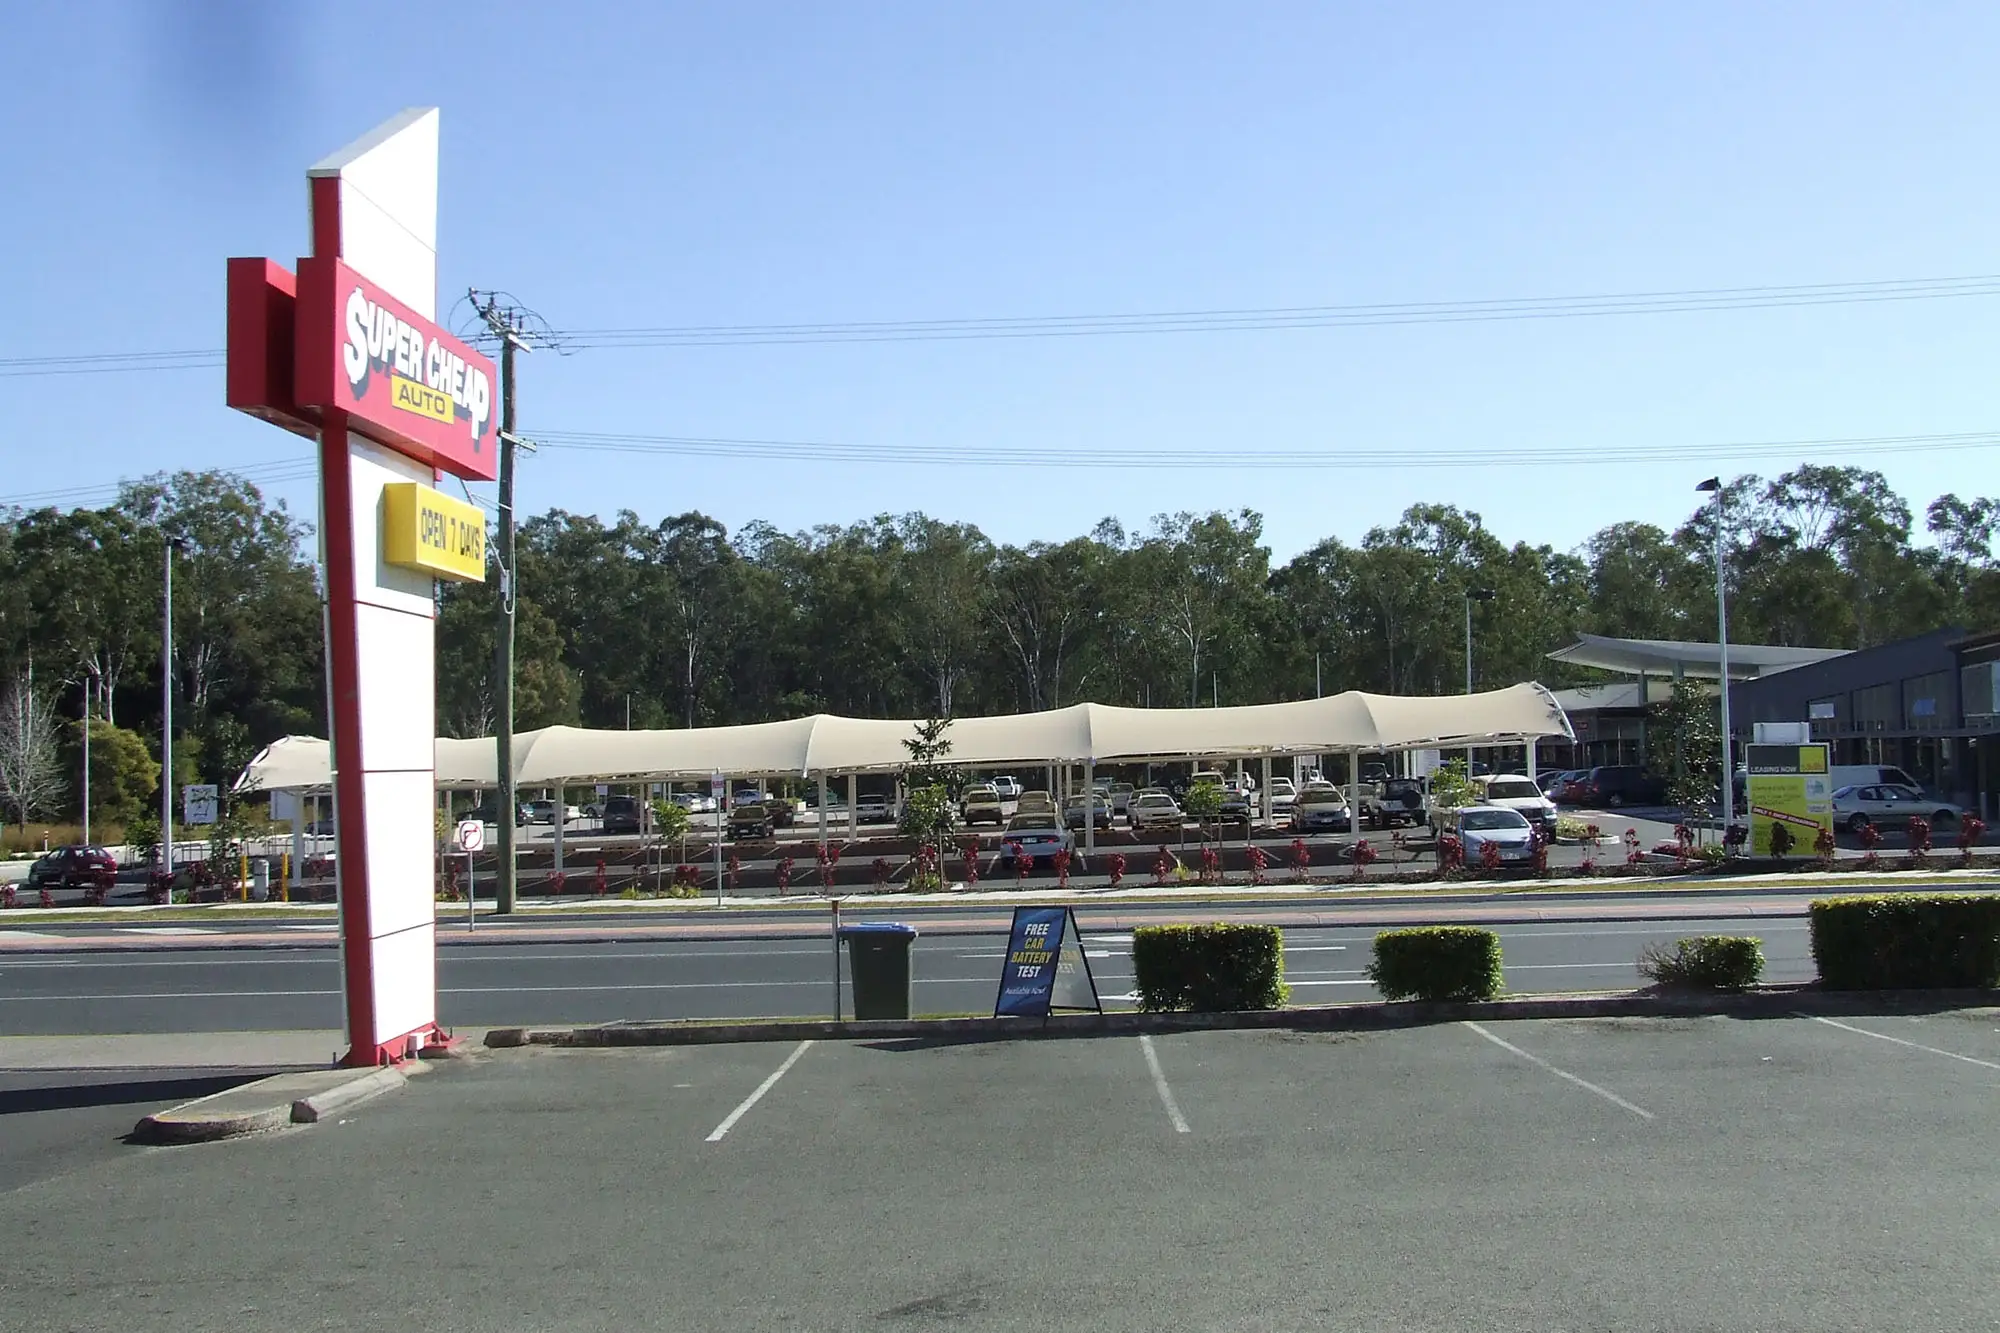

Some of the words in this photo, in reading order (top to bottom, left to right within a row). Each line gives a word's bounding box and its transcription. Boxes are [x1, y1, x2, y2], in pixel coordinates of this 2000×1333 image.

[344, 286, 424, 385] SUPER
[426, 337, 490, 440] CHEAP
[398, 384, 446, 415] AUTO
[421, 507, 446, 550] OPEN
[450, 518, 456, 553] 7
[460, 521, 481, 561] DAYS
[1024, 923, 1050, 936] FREE
[1024, 937, 1045, 949] CAR
[1011, 951, 1053, 963] BATTERY
[1017, 965, 1041, 978] TEST
